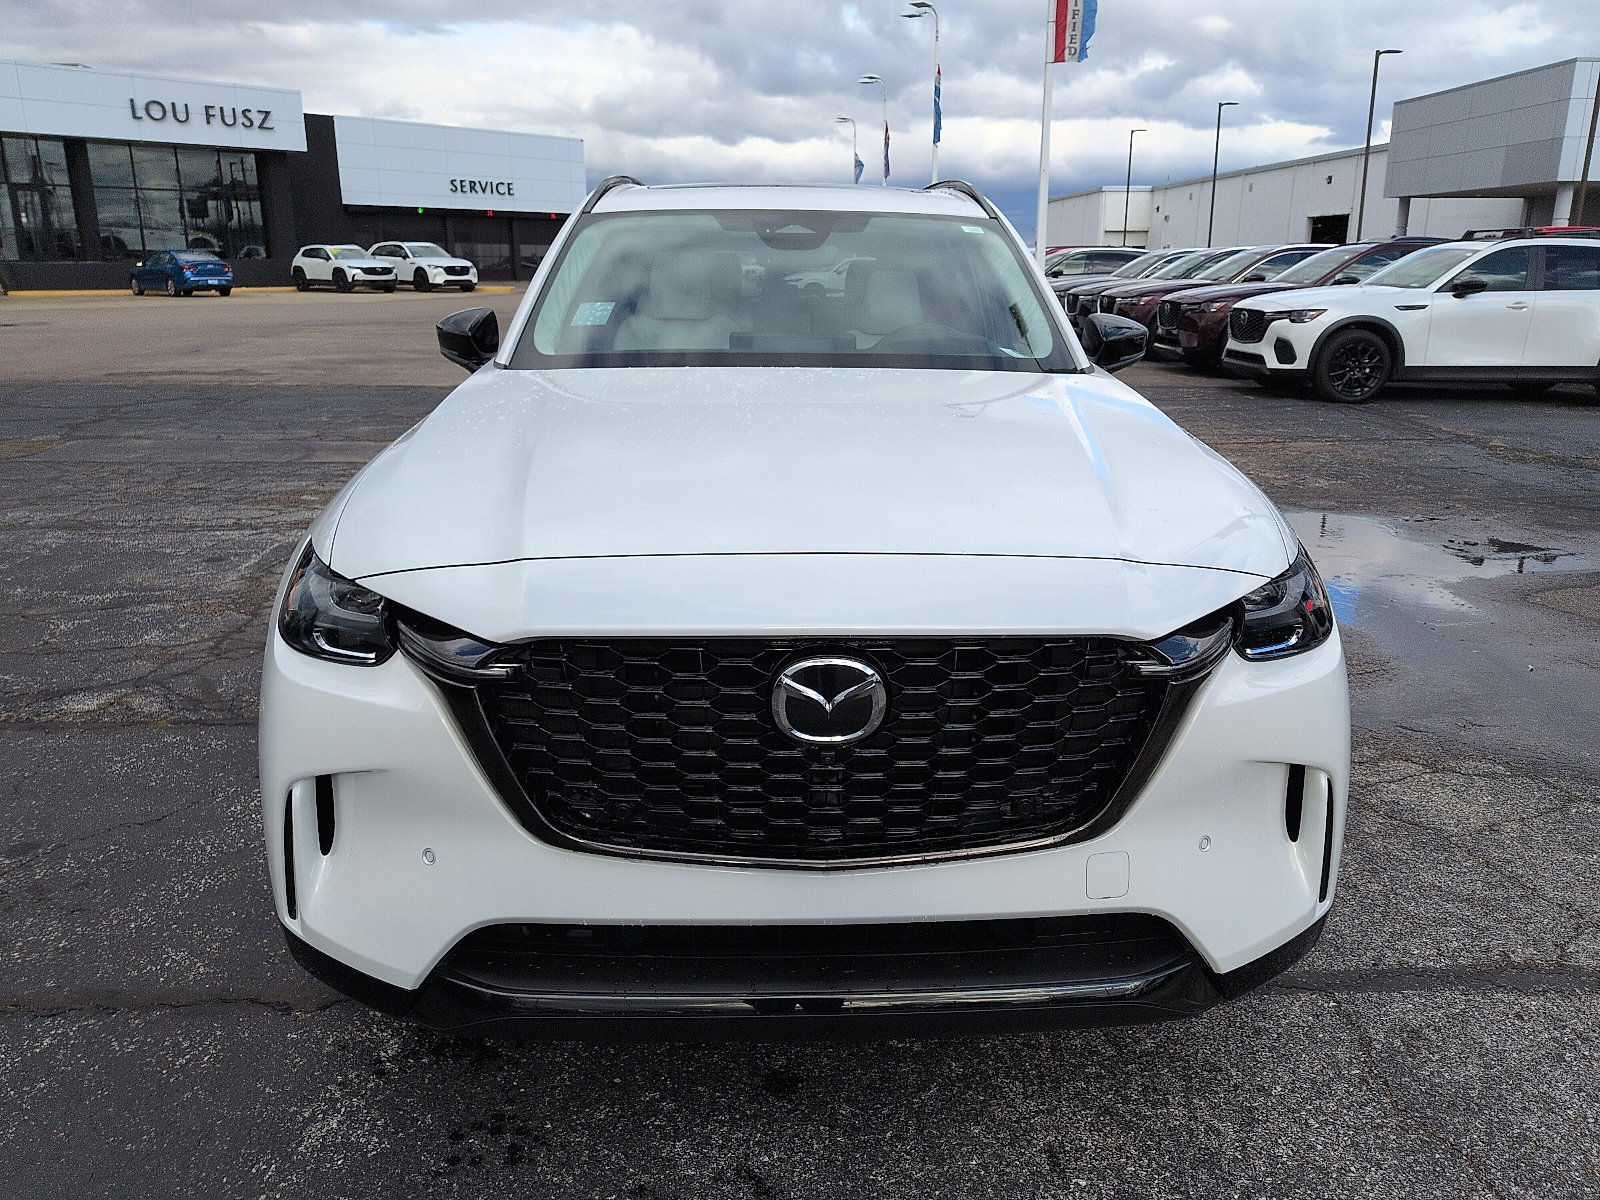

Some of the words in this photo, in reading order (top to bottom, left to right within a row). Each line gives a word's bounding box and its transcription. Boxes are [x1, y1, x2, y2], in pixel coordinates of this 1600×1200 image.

[129, 98, 190, 123] LOU
[204, 105, 275, 130] FUSZ
[449, 179, 515, 196] SERVICE
